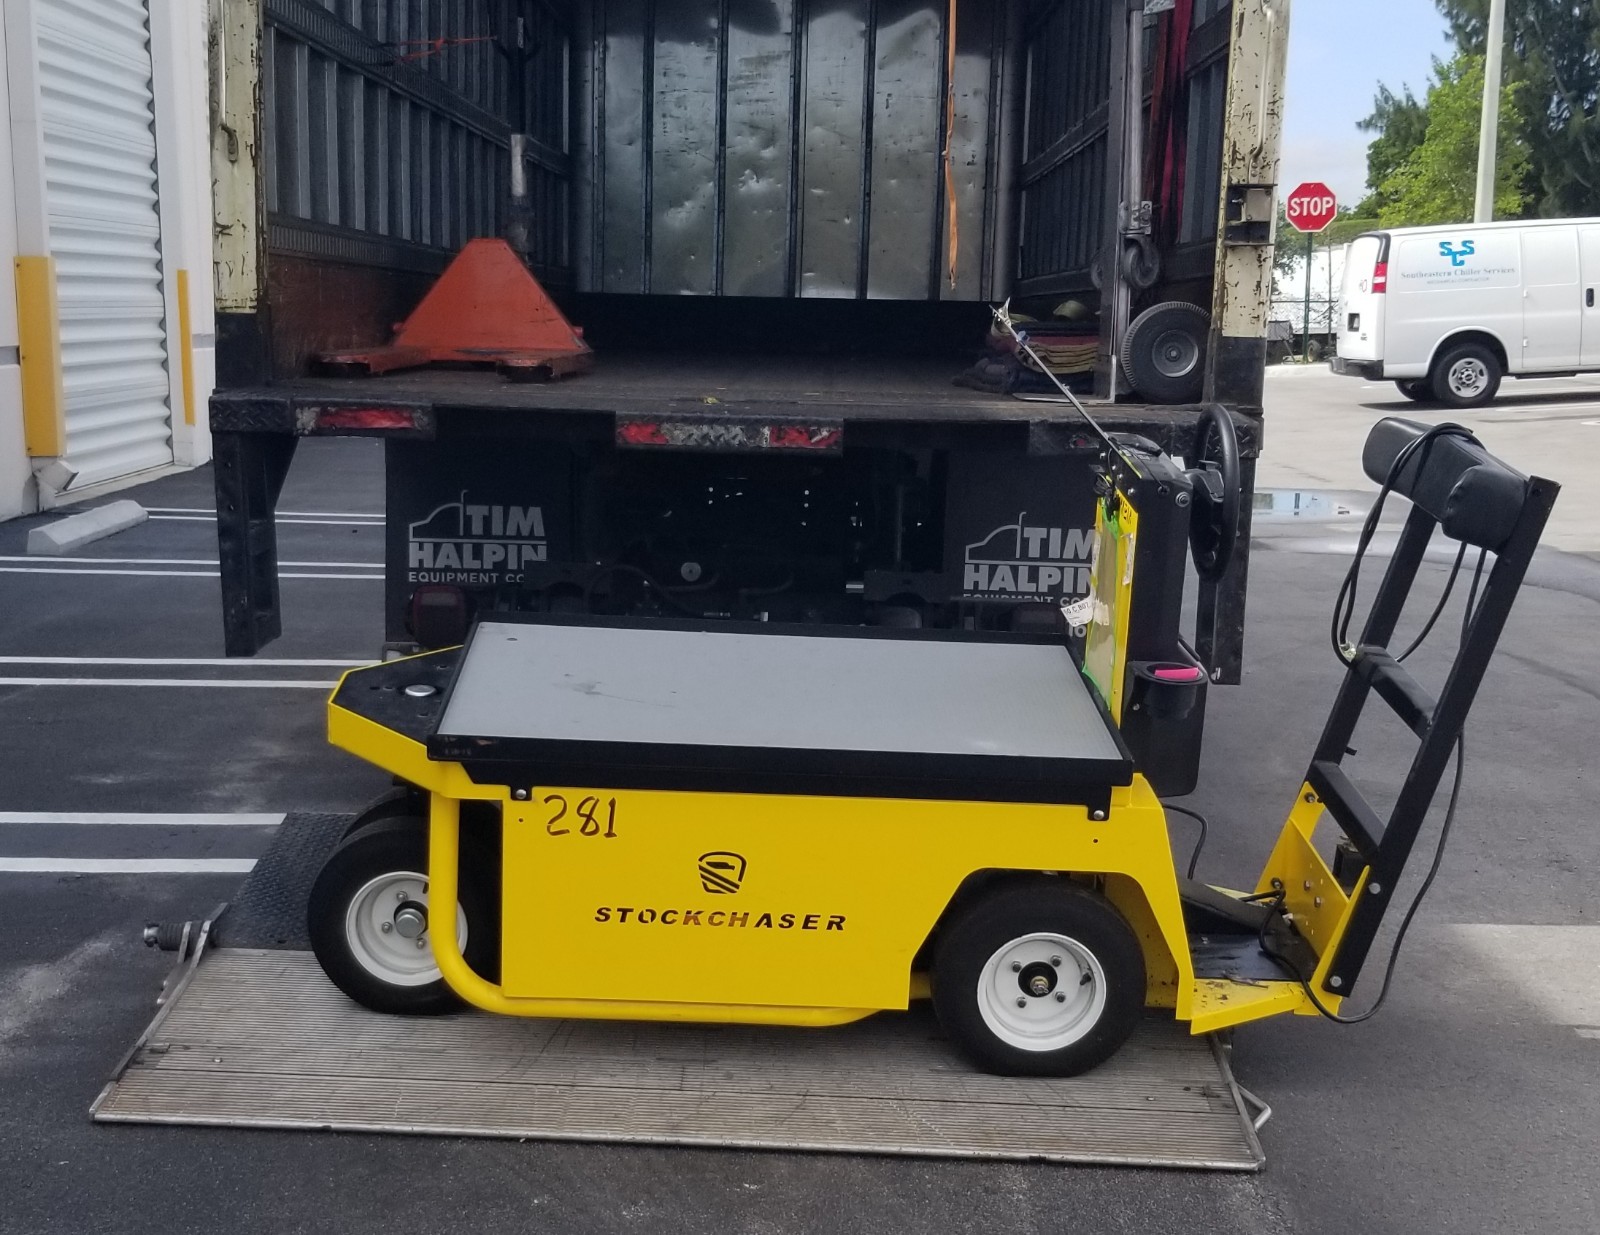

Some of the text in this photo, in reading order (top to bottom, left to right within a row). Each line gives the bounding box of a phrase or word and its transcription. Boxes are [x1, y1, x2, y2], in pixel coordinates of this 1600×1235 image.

[1290, 197, 1334, 217] STOP
[1401, 266, 1516, 279] Southeastern Chiller Services
[466, 505, 545, 536] TIM
[409, 542, 547, 570] HALPIN
[1023, 527, 1096, 559] TIM
[408, 571, 499, 583] EQUIPMENT
[963, 564, 1092, 593] HALPIN
[543, 794, 618, 838] 281
[594, 907, 847, 931] STOCKCHASER
